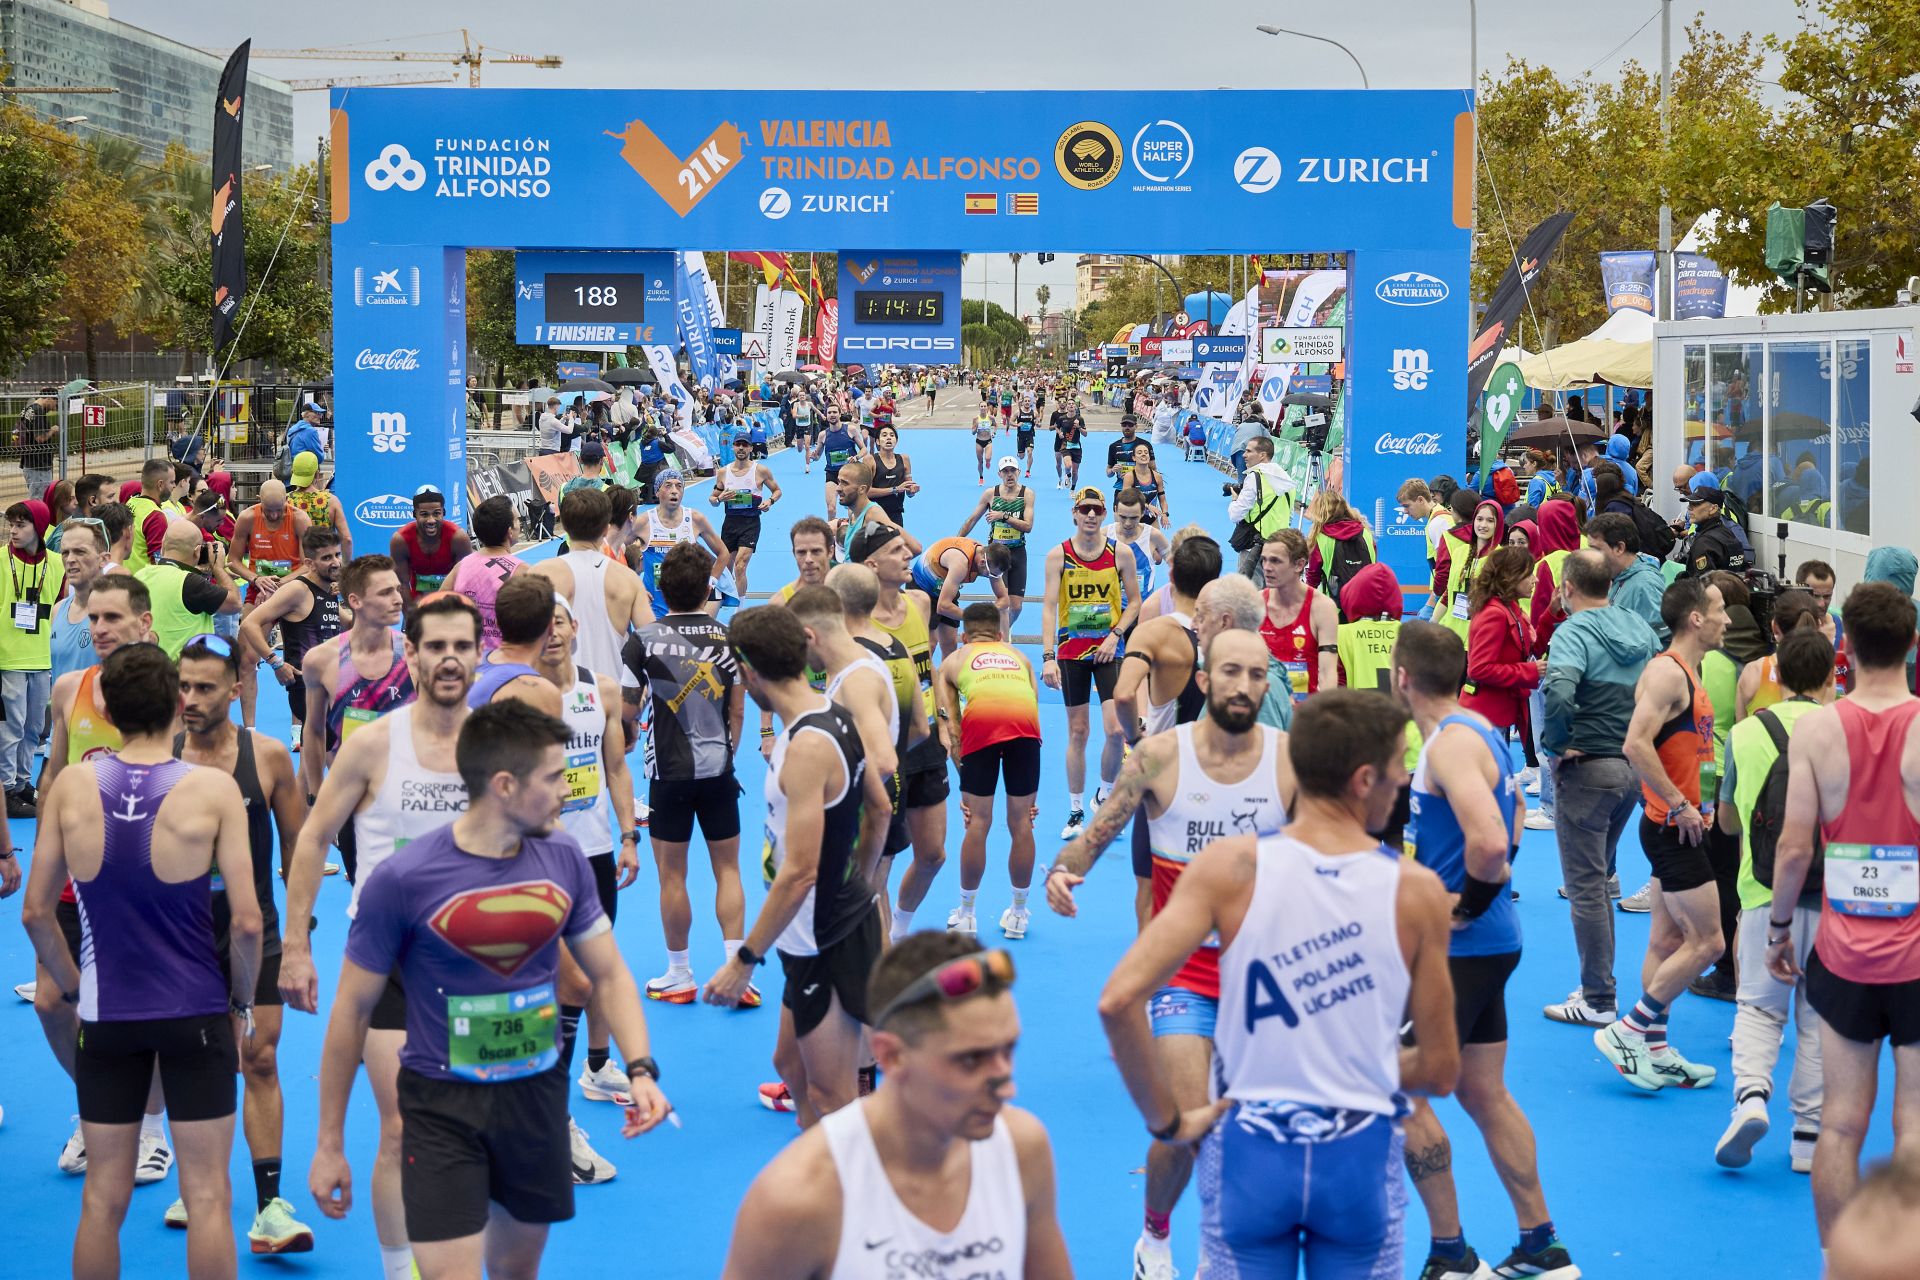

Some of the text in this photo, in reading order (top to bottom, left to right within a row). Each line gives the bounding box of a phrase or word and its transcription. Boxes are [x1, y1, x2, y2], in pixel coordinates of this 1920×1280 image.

[760, 120, 891, 147] VALENCIA
[435, 137, 549, 152] FUNDACIÓN
[1143, 141, 1183, 151] SUPER
[1143, 152, 1183, 161] HALFS
[434, 156, 550, 175] TRINIDAD
[678, 140, 730, 199] 21K
[760, 156, 1041, 180] TRINIDAD ALFONSO
[1298, 158, 1429, 183] ZURICH
[435, 178, 550, 198] ALFONSO
[801, 195, 889, 214] ZURICH
[574, 286, 617, 306] 188
[1381, 286, 1443, 298] ASTURIANA
[1678, 287, 1717, 297] madrugar
[366, 295, 408, 306] CaixaBank
[535, 326, 543, 341] 1
[547, 326, 615, 342] FINISHER
[635, 326, 654, 342] 1€
[780, 307, 797, 368] CaixaBank
[843, 337, 955, 350] COROS
[355, 348, 420, 371] Coca-Cola
[1294, 348, 1334, 356] ALFONSO
[1375, 432, 1442, 455] Coca-Cola
[1069, 584, 1110, 599] UPV
[658, 625, 726, 636] LA CEREZAL
[975, 658, 1018, 668] Serrano
[675, 670, 706, 705] RIBADESELLA
[564, 773, 578, 783] 27
[1187, 821, 1225, 836] BULL
[1862, 866, 1878, 879] 23
[1853, 886, 1889, 898] CROSS
[1293, 953, 1365, 992] POLANA
[492, 1018, 524, 1037] 736
[478, 1044, 518, 1060] Óscar
